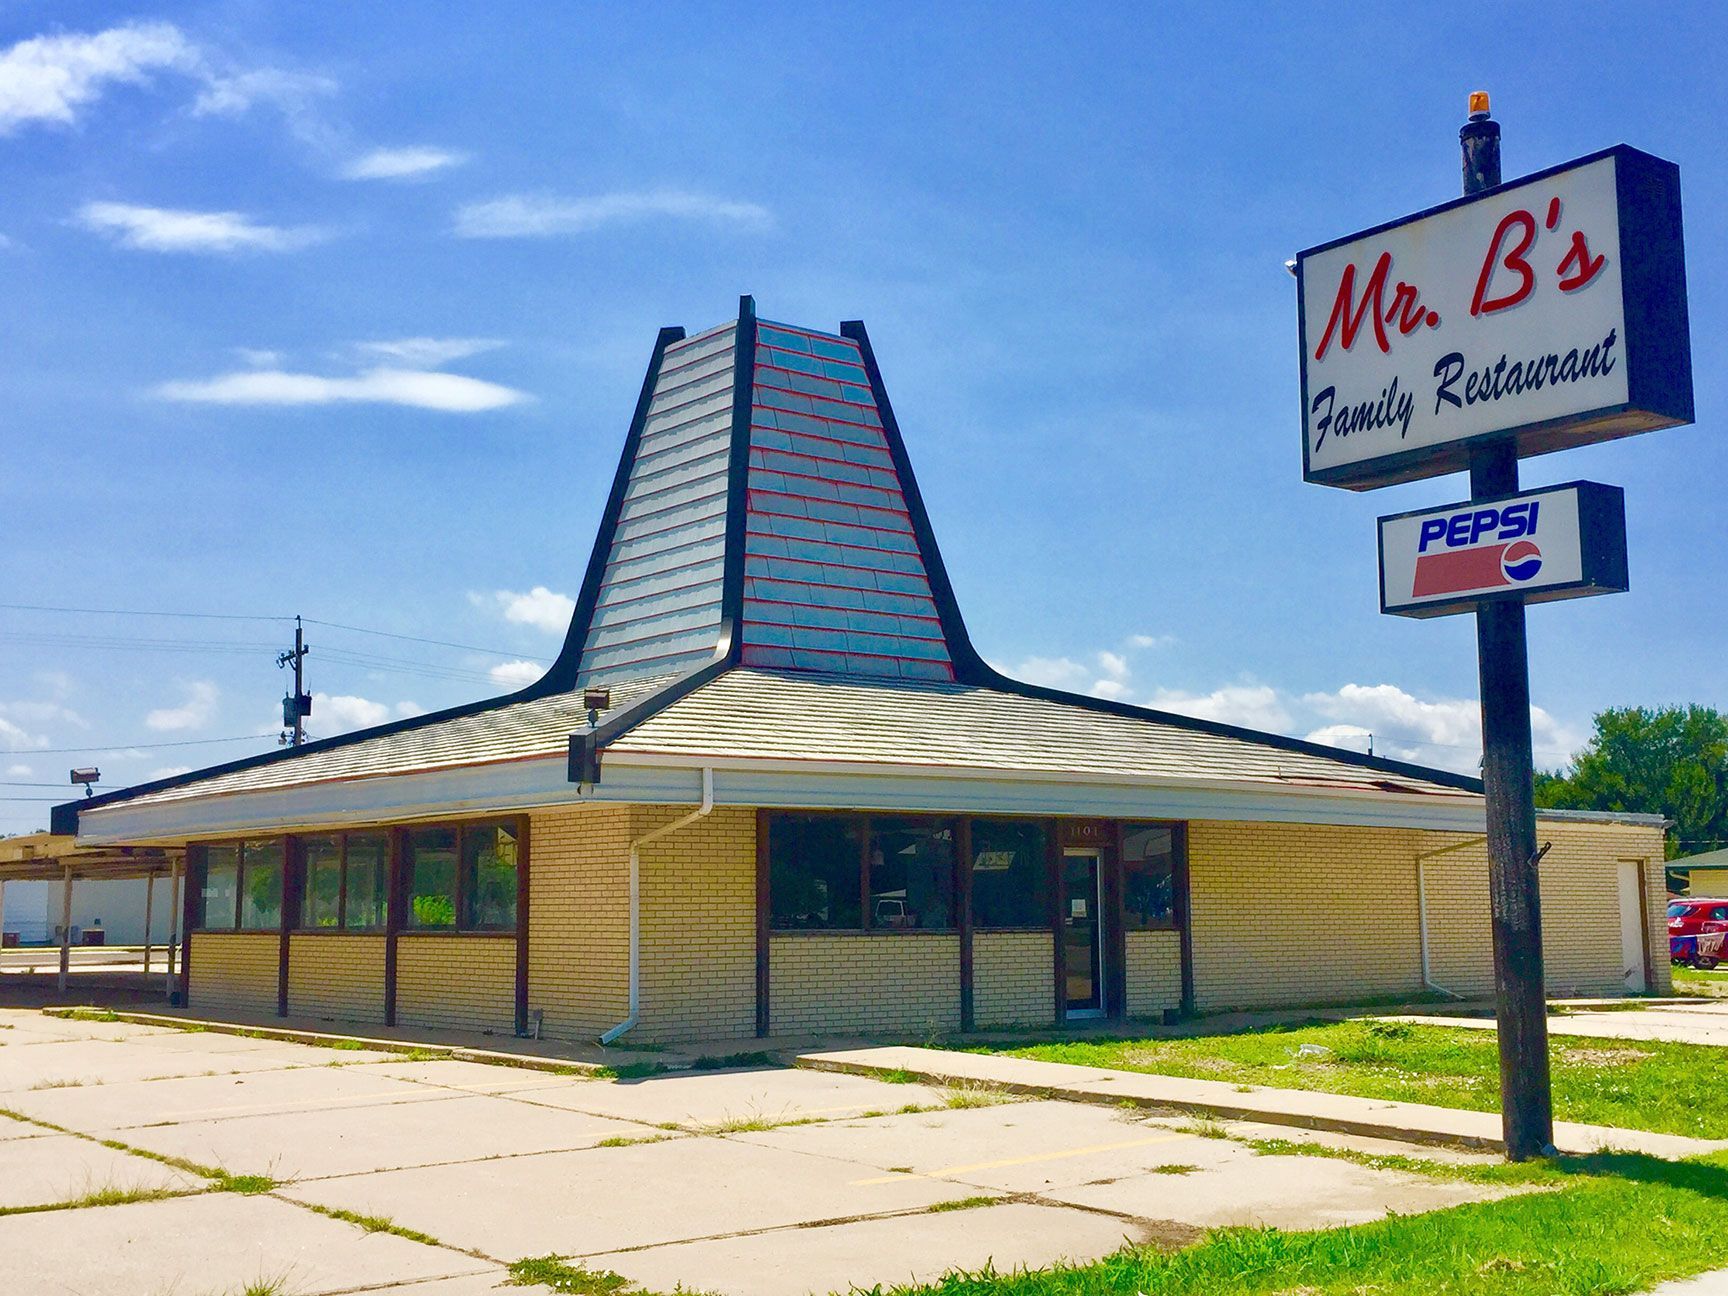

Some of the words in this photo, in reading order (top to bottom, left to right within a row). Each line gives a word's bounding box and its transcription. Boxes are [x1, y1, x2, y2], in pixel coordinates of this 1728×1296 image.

[1315, 252, 1439, 360] Mr.
[1470, 197, 1606, 316] B's
[1311, 376, 1415, 453] Family
[1433, 328, 1616, 415] Restaurant
[1418, 501, 1540, 553] PEPSI
[1071, 825, 1099, 837] 1101
